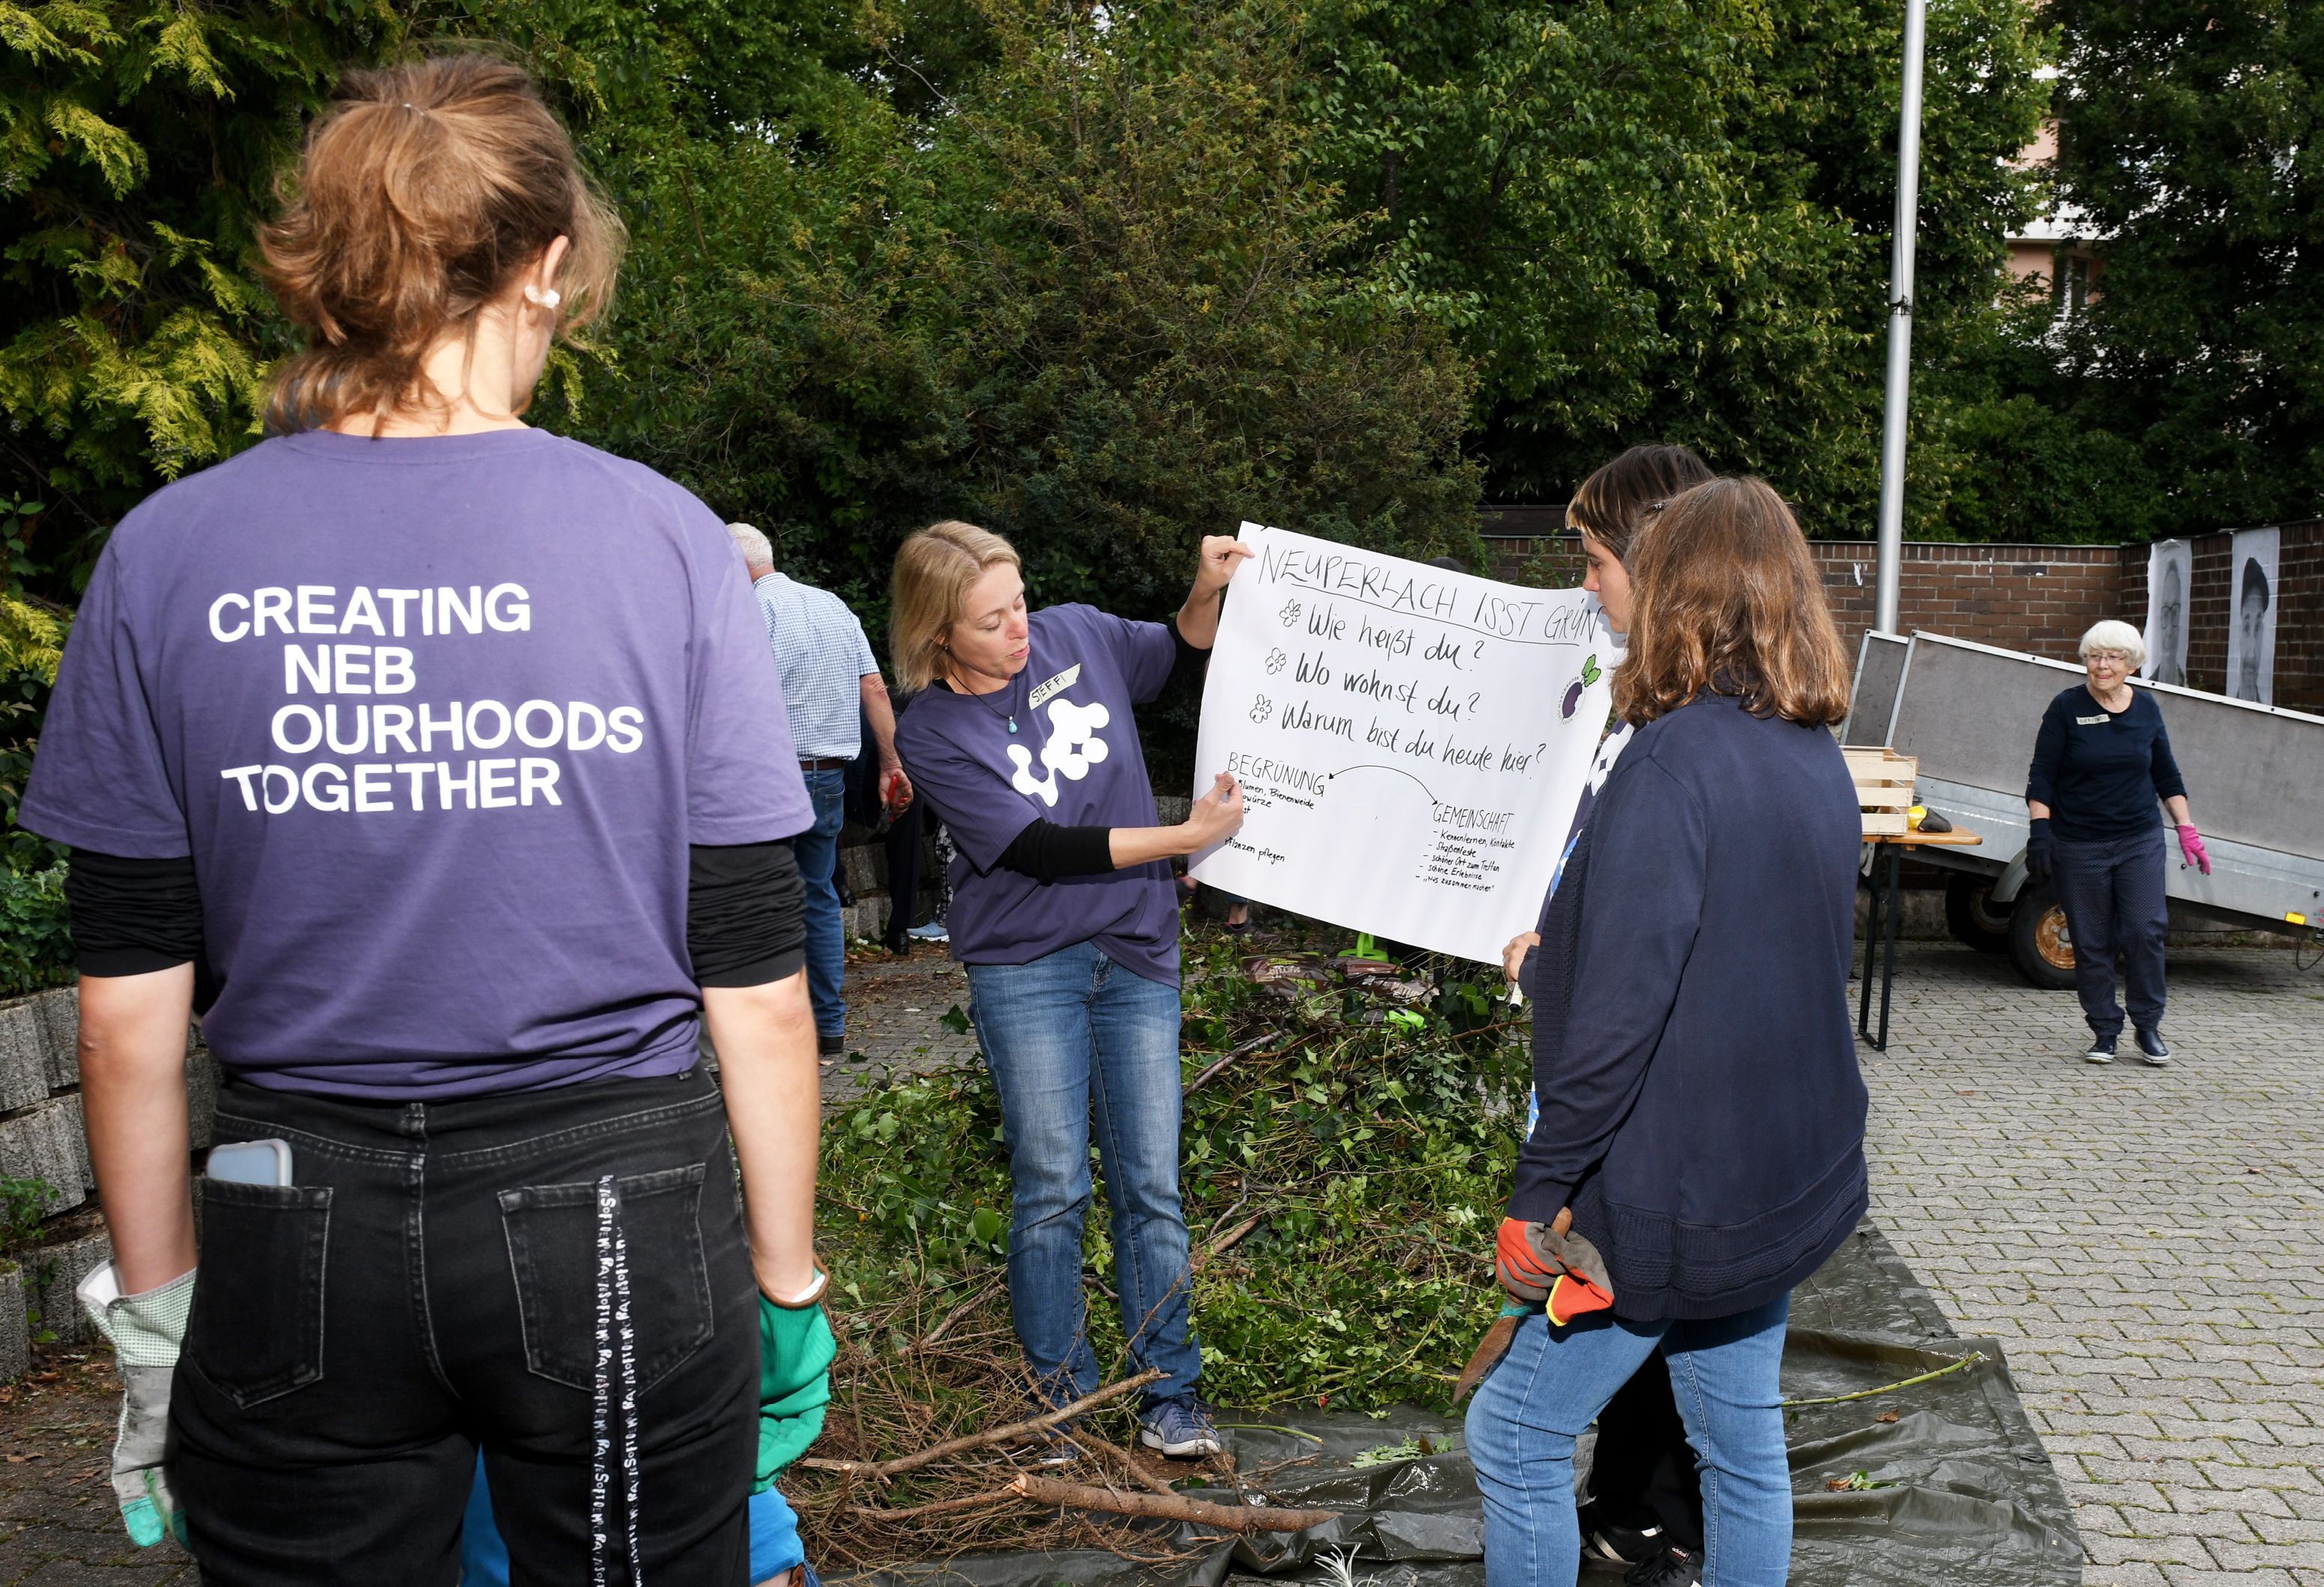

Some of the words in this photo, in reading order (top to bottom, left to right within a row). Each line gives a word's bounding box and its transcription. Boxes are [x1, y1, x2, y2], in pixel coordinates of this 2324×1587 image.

[1259, 544, 1457, 618] NEUPERLACH
[1473, 592, 1545, 637] ISST
[210, 583, 530, 642] CREATING
[1308, 602, 1346, 640] Wie
[1359, 614, 1417, 661] heißt
[285, 645, 416, 694] NEB
[1295, 651, 1330, 685] Wo
[1343, 669, 1418, 714] wohnst
[1031, 674, 1067, 704] STEFFI
[272, 700, 644, 754] OURHOODS
[1281, 700, 1356, 742] Warum
[1366, 715, 1400, 753] bist
[1405, 729, 1435, 759] du
[1442, 734, 1493, 770] heute
[222, 758, 562, 813] TOGETHER
[1227, 751, 1324, 798] BEGRÜNUNG
[1242, 794, 1272, 808] ewürze
[1269, 787, 1315, 810] Bienenweide
[1433, 802, 1515, 835] GEMEINSCHAFT
[1257, 847, 1286, 866] pflegen
[1436, 841, 1477, 858] Straßenfeste
[1489, 838, 1515, 849] Kontakte
[1450, 867, 1482, 881] Erlebnisse
[1455, 856, 1467, 867] Ort
[1467, 861, 1479, 870] zum
[1671, 1547, 1688, 1558] adidas
